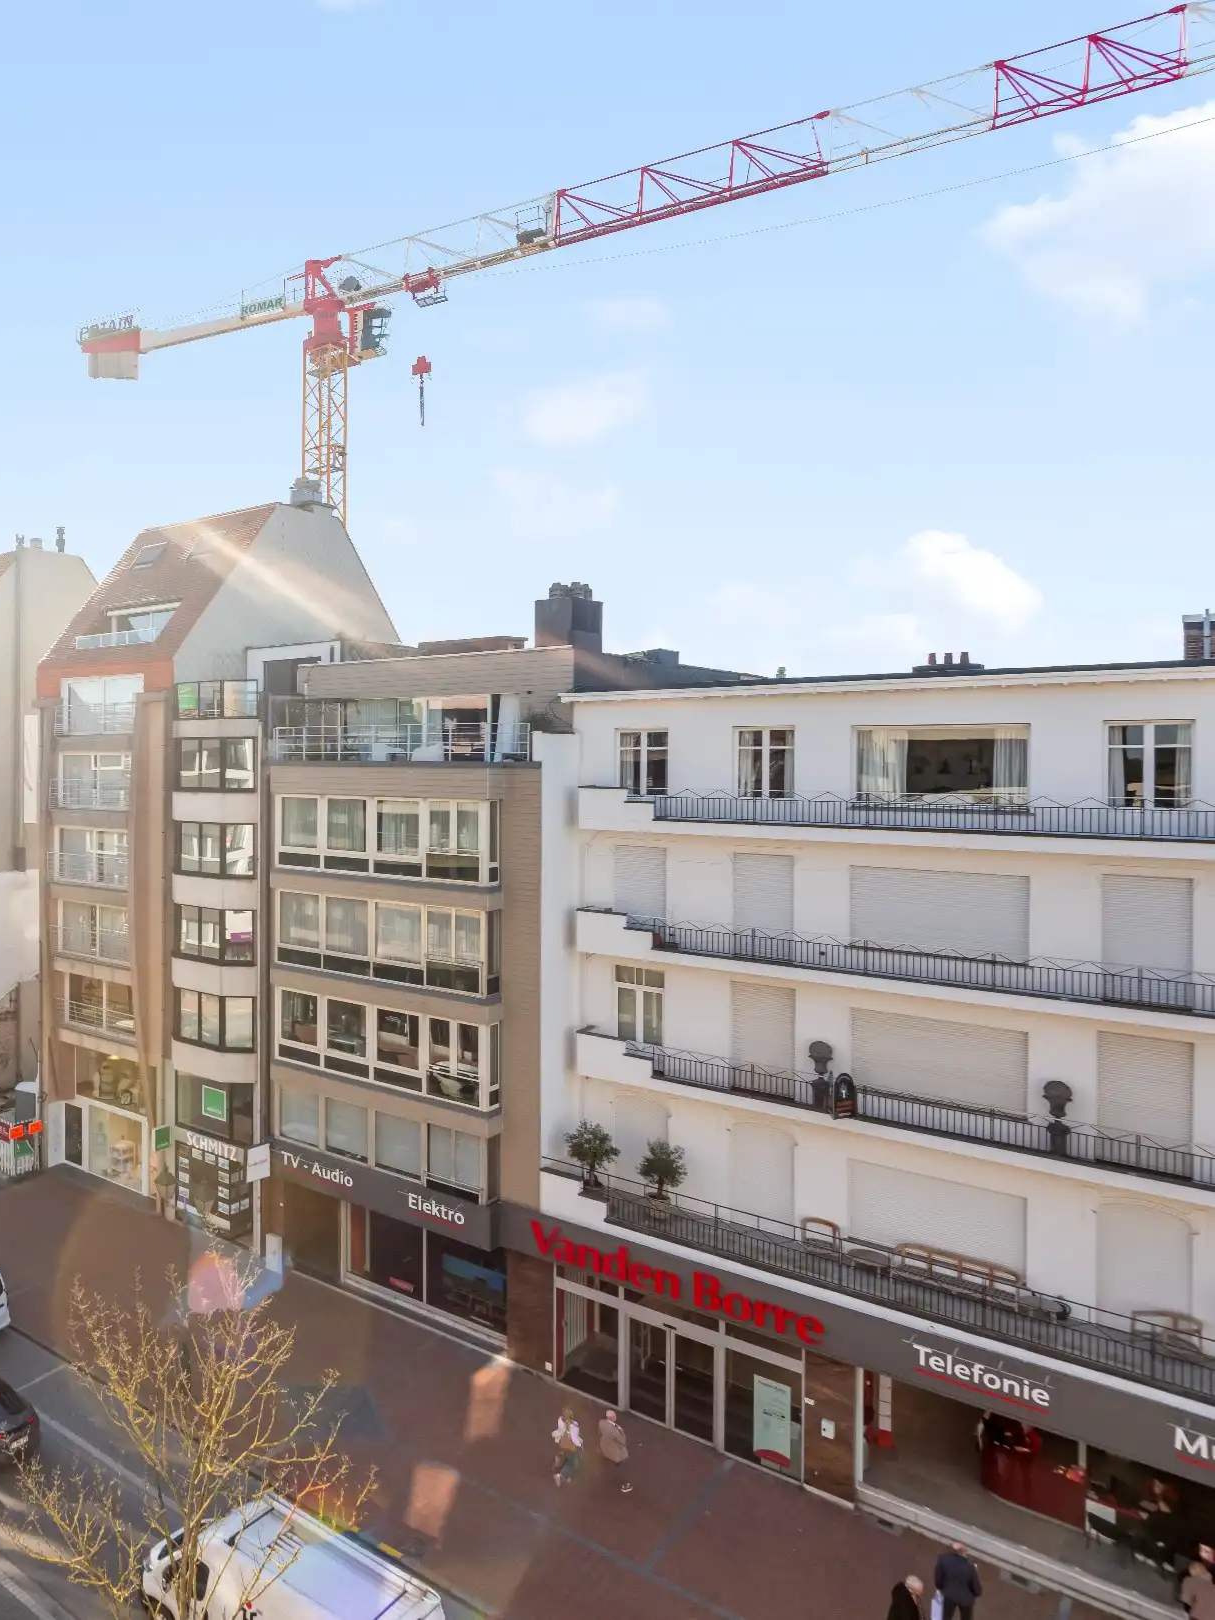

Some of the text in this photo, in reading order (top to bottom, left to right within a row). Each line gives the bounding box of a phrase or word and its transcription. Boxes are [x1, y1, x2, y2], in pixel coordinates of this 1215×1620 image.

[186, 1131, 237, 1161] SCHMITZ
[281, 1150, 300, 1169] TV
[311, 1162, 353, 1187] Audio
[408, 1192, 465, 1225] Elektro
[529, 1219, 824, 1346] Vanden Borre
[912, 1343, 1050, 1407] Telefonie
